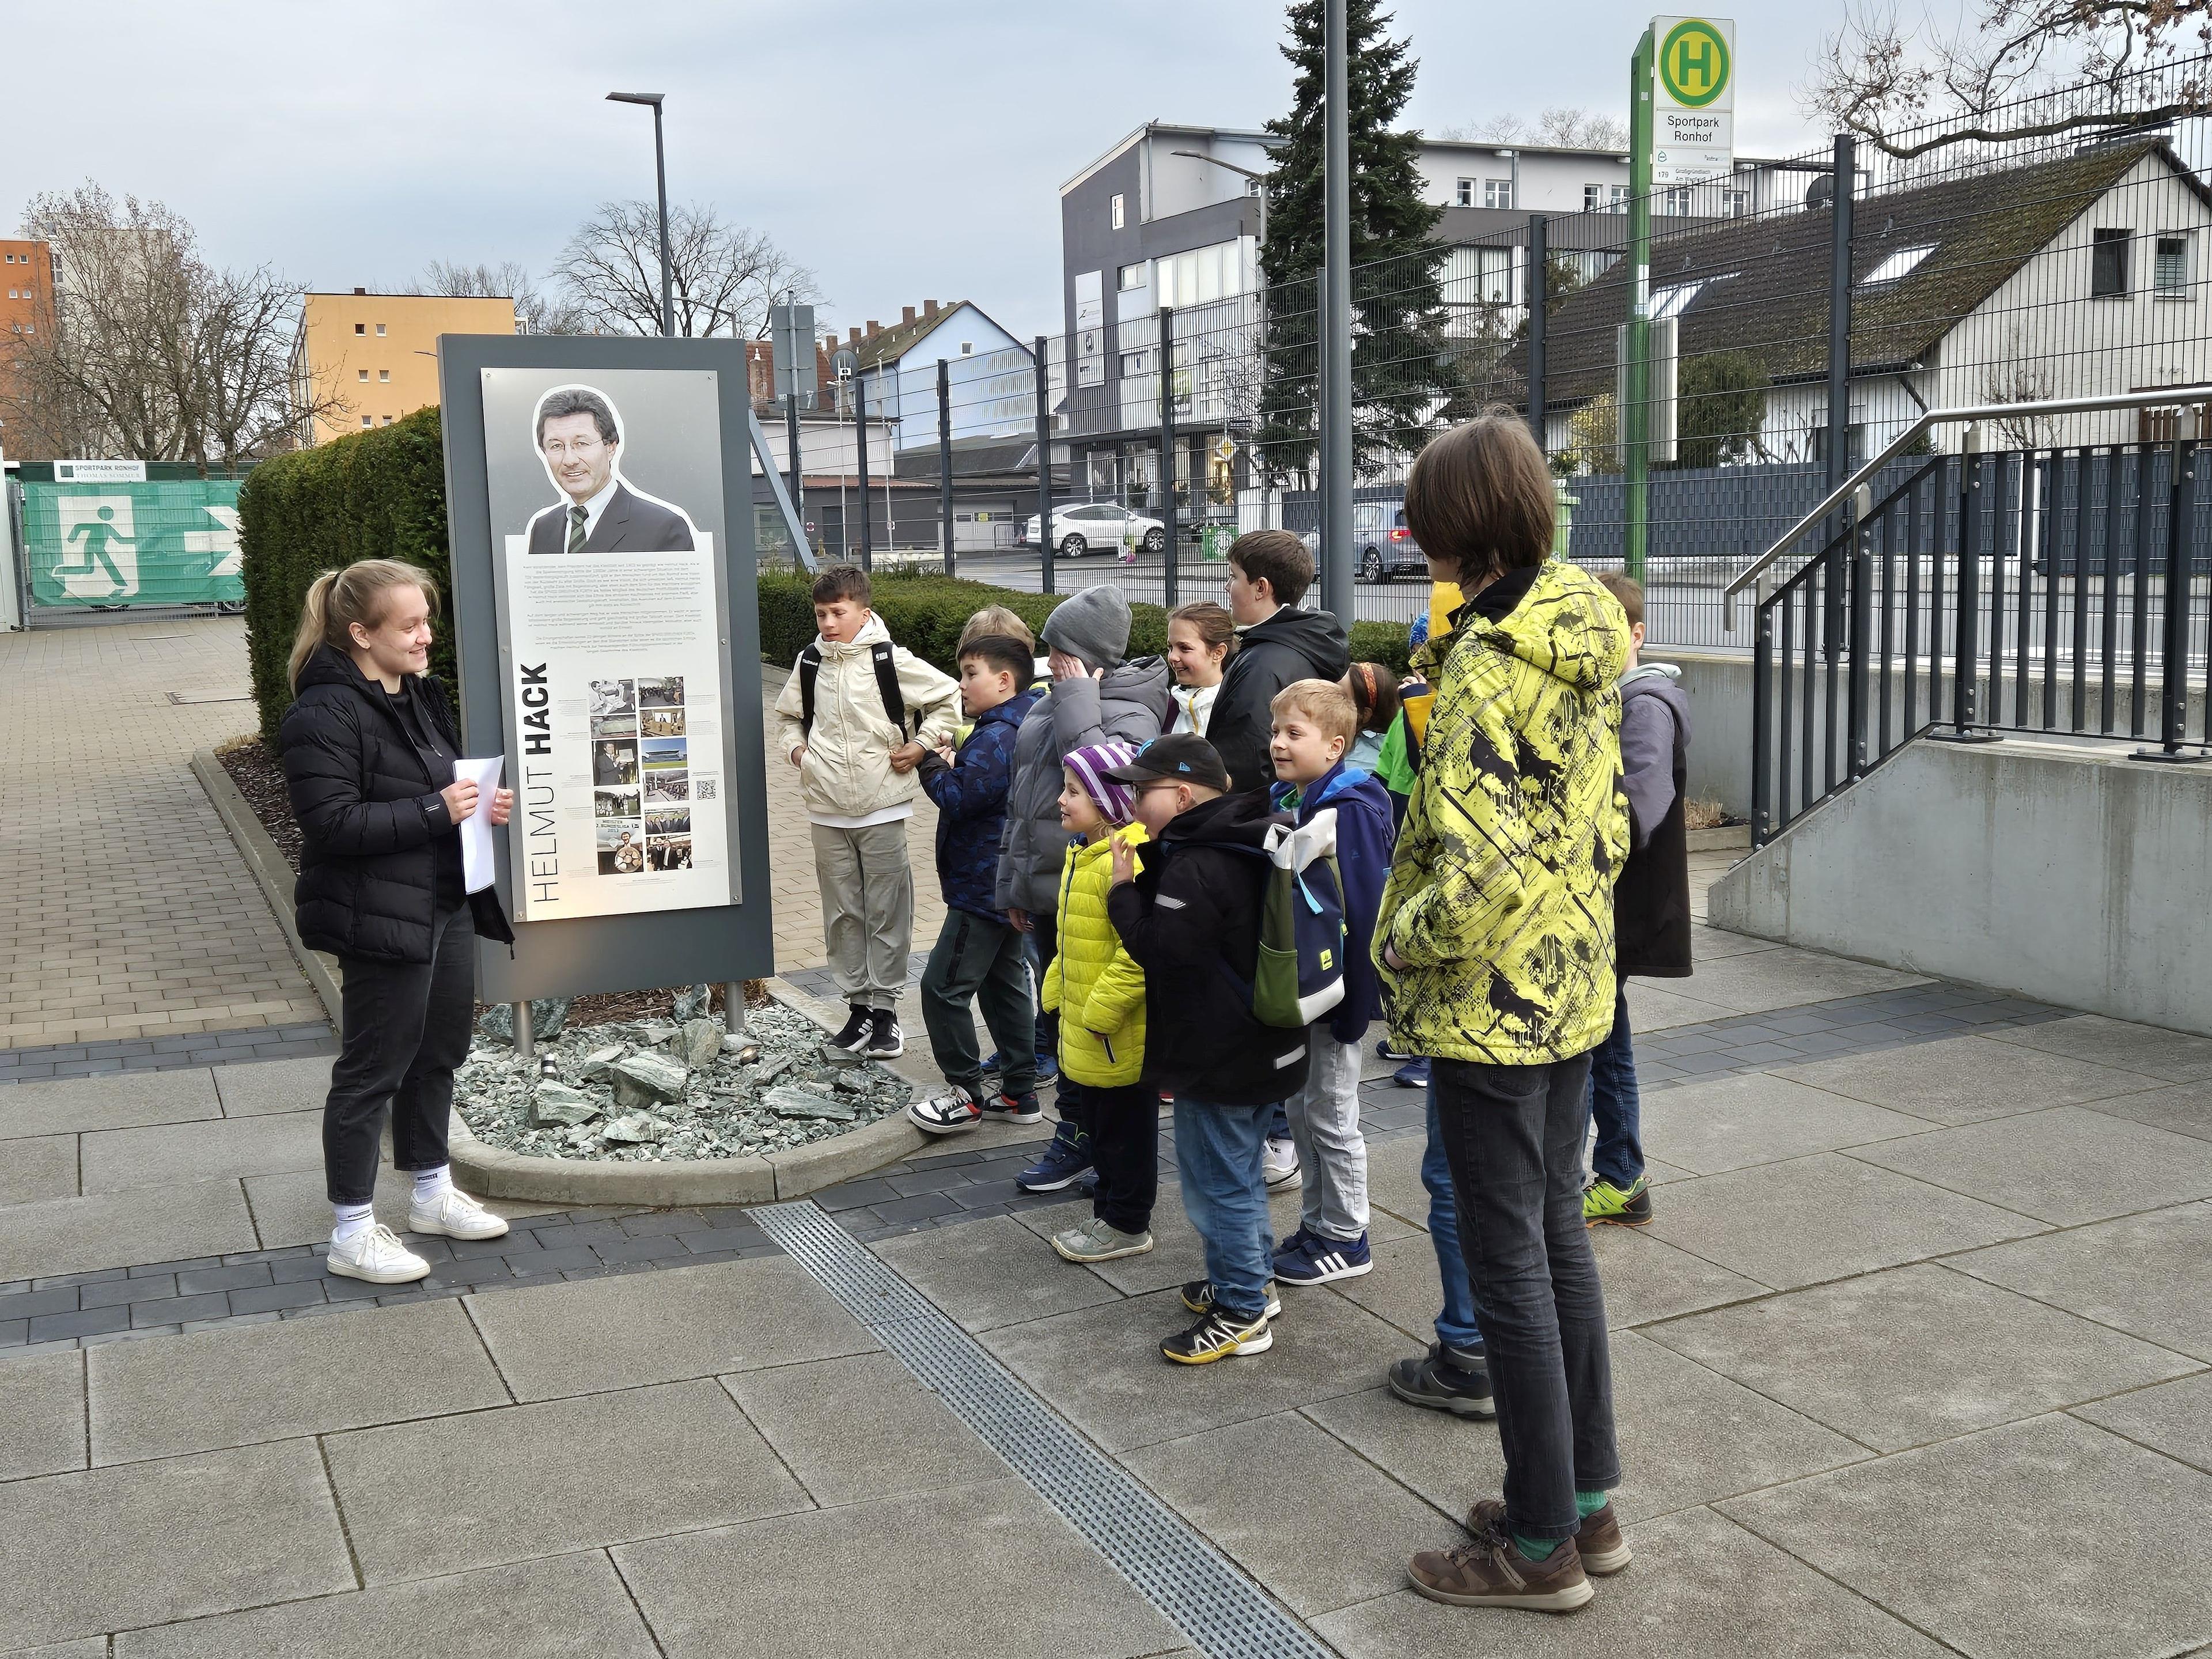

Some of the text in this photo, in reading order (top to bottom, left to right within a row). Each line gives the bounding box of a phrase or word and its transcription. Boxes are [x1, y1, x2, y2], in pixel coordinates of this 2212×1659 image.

[1678, 40, 1711, 87] H
[1668, 115, 1719, 128] Sportpark
[1674, 131, 1713, 142] Ronhof
[520, 662, 559, 903] HELMUT HACK
